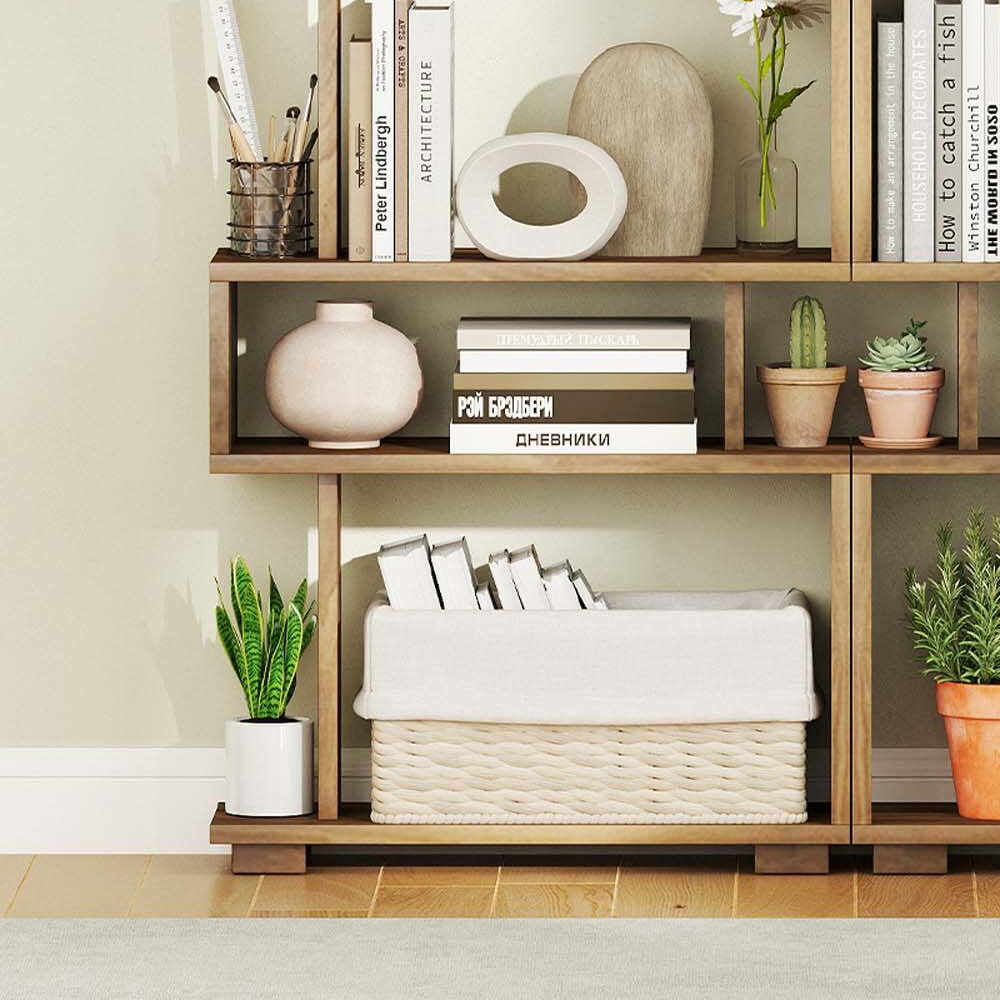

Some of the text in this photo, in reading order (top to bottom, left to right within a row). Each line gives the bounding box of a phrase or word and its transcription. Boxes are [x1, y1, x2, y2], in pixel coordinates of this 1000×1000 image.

[398, 18, 406, 41] ARTS
[398, 55, 406, 88] CRAFTS
[886, 62, 897, 80] the
[420, 60, 432, 183] ARCHITECTURE
[911, 28, 928, 223] HOUSEHOLD DECORATES
[937, 15, 956, 252] How to catch a fish
[375, 115, 391, 232] Peter Lindbergh
[967, 84, 980, 252] Winston Churchill
[886, 218, 897, 231] to
[886, 236, 897, 256] How
[457, 391, 554, 420] РЭЙ БРЭДБЕРИ
[515, 433, 610, 448] ДНЕВНИКИ
